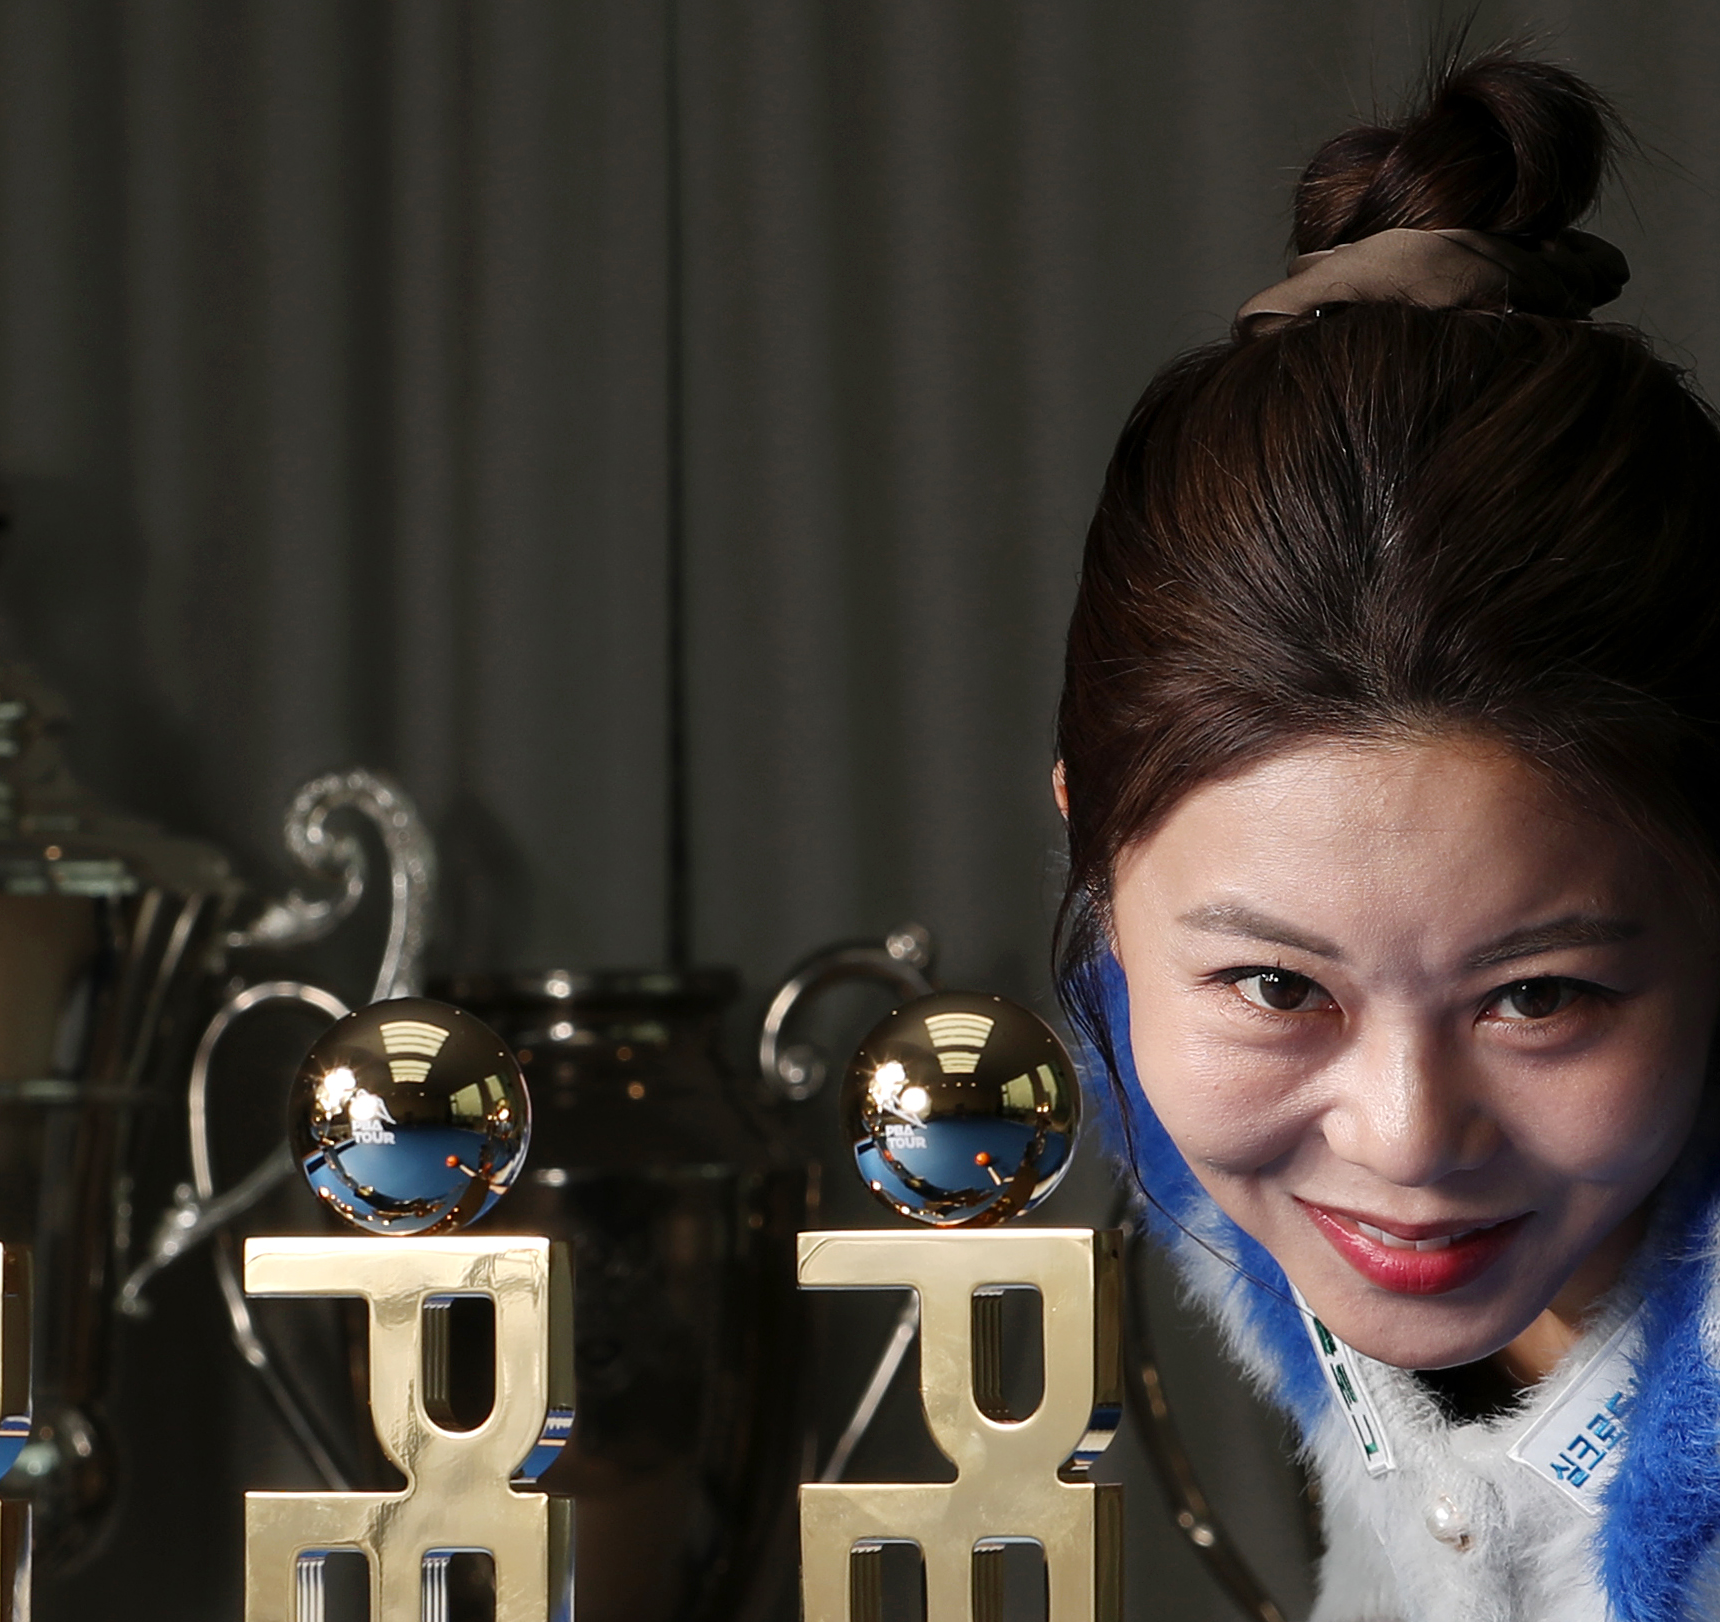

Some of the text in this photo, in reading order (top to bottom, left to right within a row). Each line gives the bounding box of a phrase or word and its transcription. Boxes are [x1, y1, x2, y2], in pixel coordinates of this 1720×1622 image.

[351, 1118, 383, 1131] PBA
[885, 1124, 915, 1136] PBA
[352, 1131, 396, 1145] TOUR
[885, 1136, 927, 1149] TOUR
